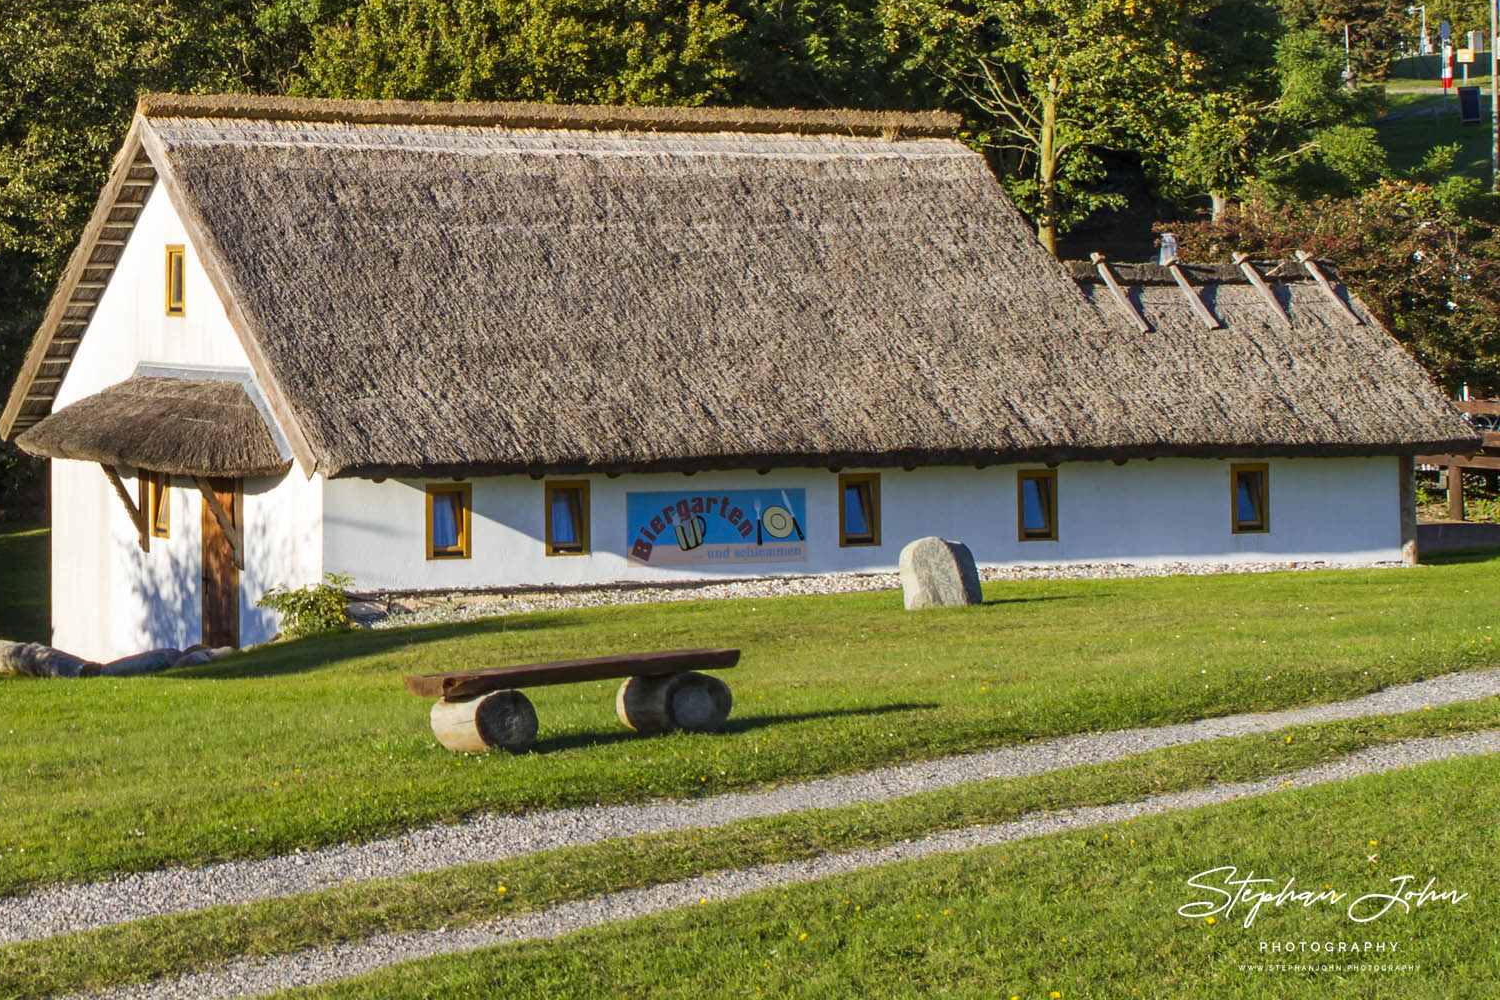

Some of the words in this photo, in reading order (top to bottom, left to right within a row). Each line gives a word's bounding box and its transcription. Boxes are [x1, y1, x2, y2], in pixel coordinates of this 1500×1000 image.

[631, 496, 755, 562] Biergarten
[707, 546, 731, 559] und
[734, 546, 802, 558] schlemmen
